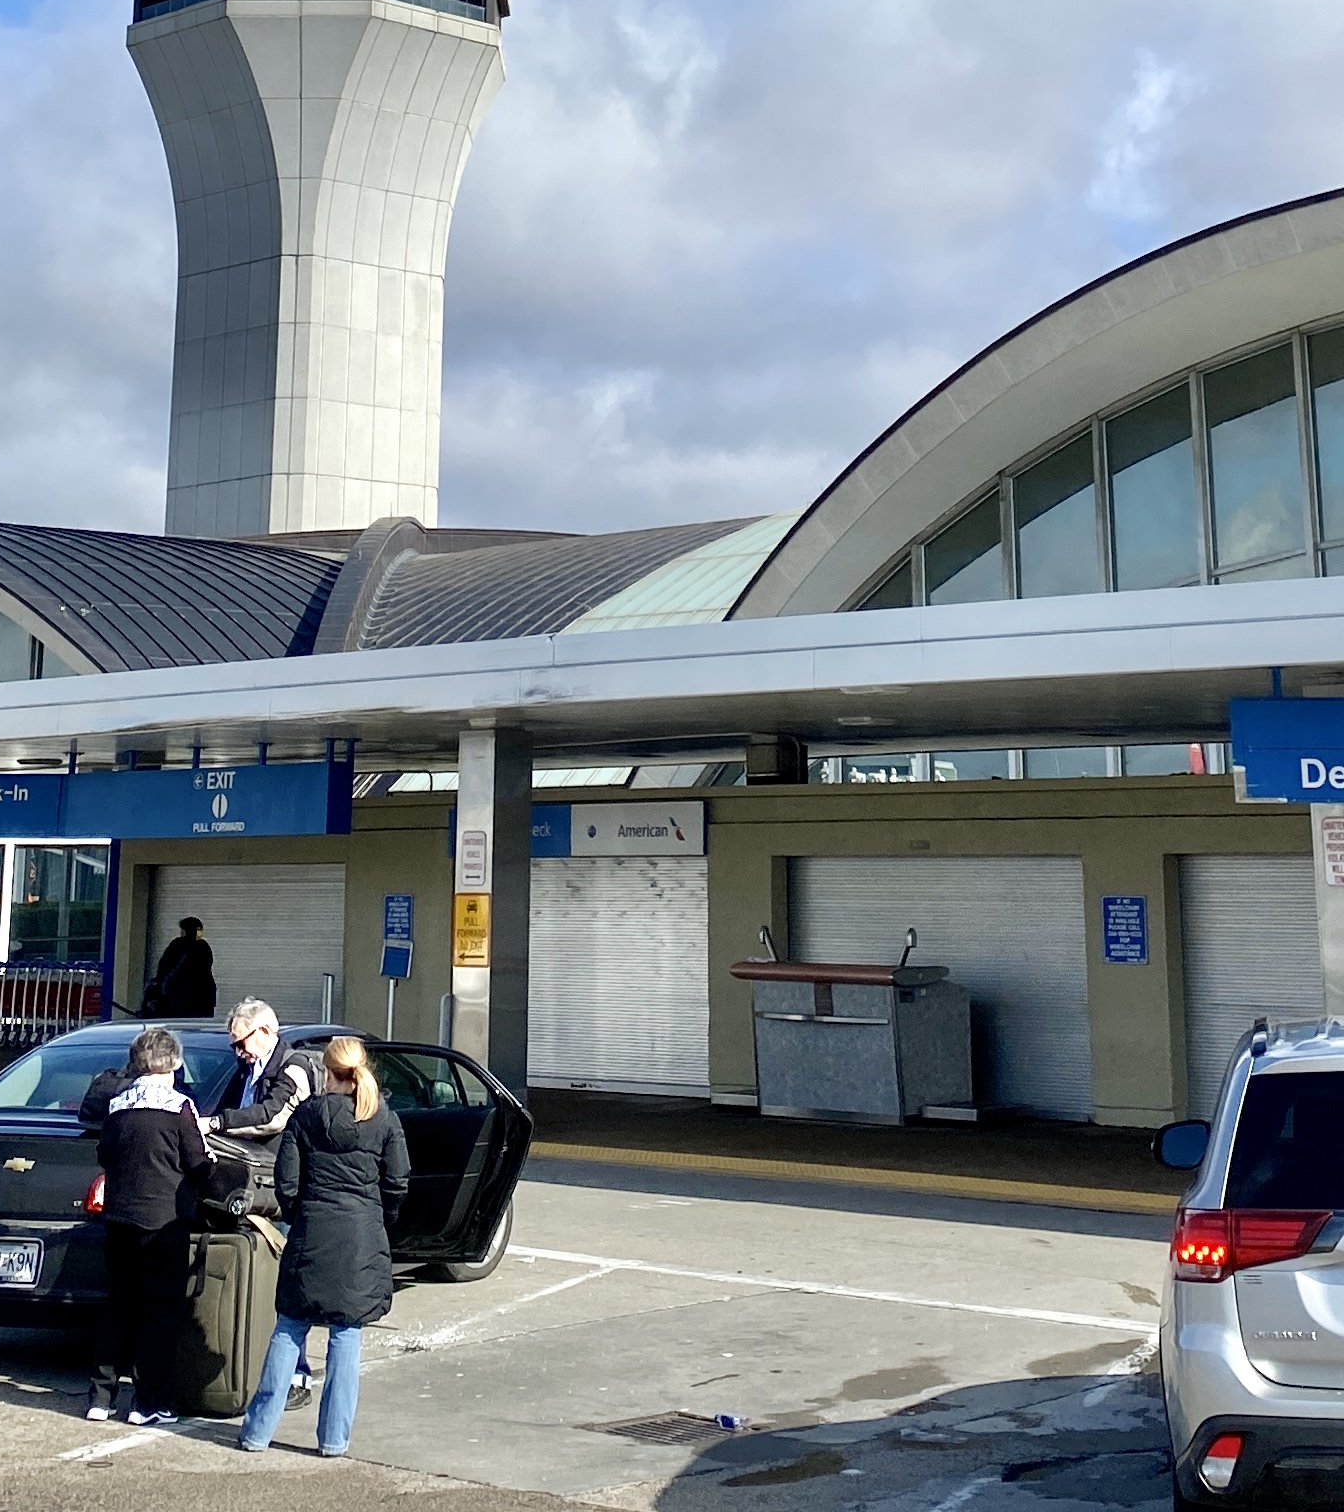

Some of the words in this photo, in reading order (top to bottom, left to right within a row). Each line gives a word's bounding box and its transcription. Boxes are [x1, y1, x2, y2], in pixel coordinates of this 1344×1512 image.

[206, 771, 236, 790] EXIT
[192, 822, 210, 833] PULL
[617, 823, 668, 838] American
